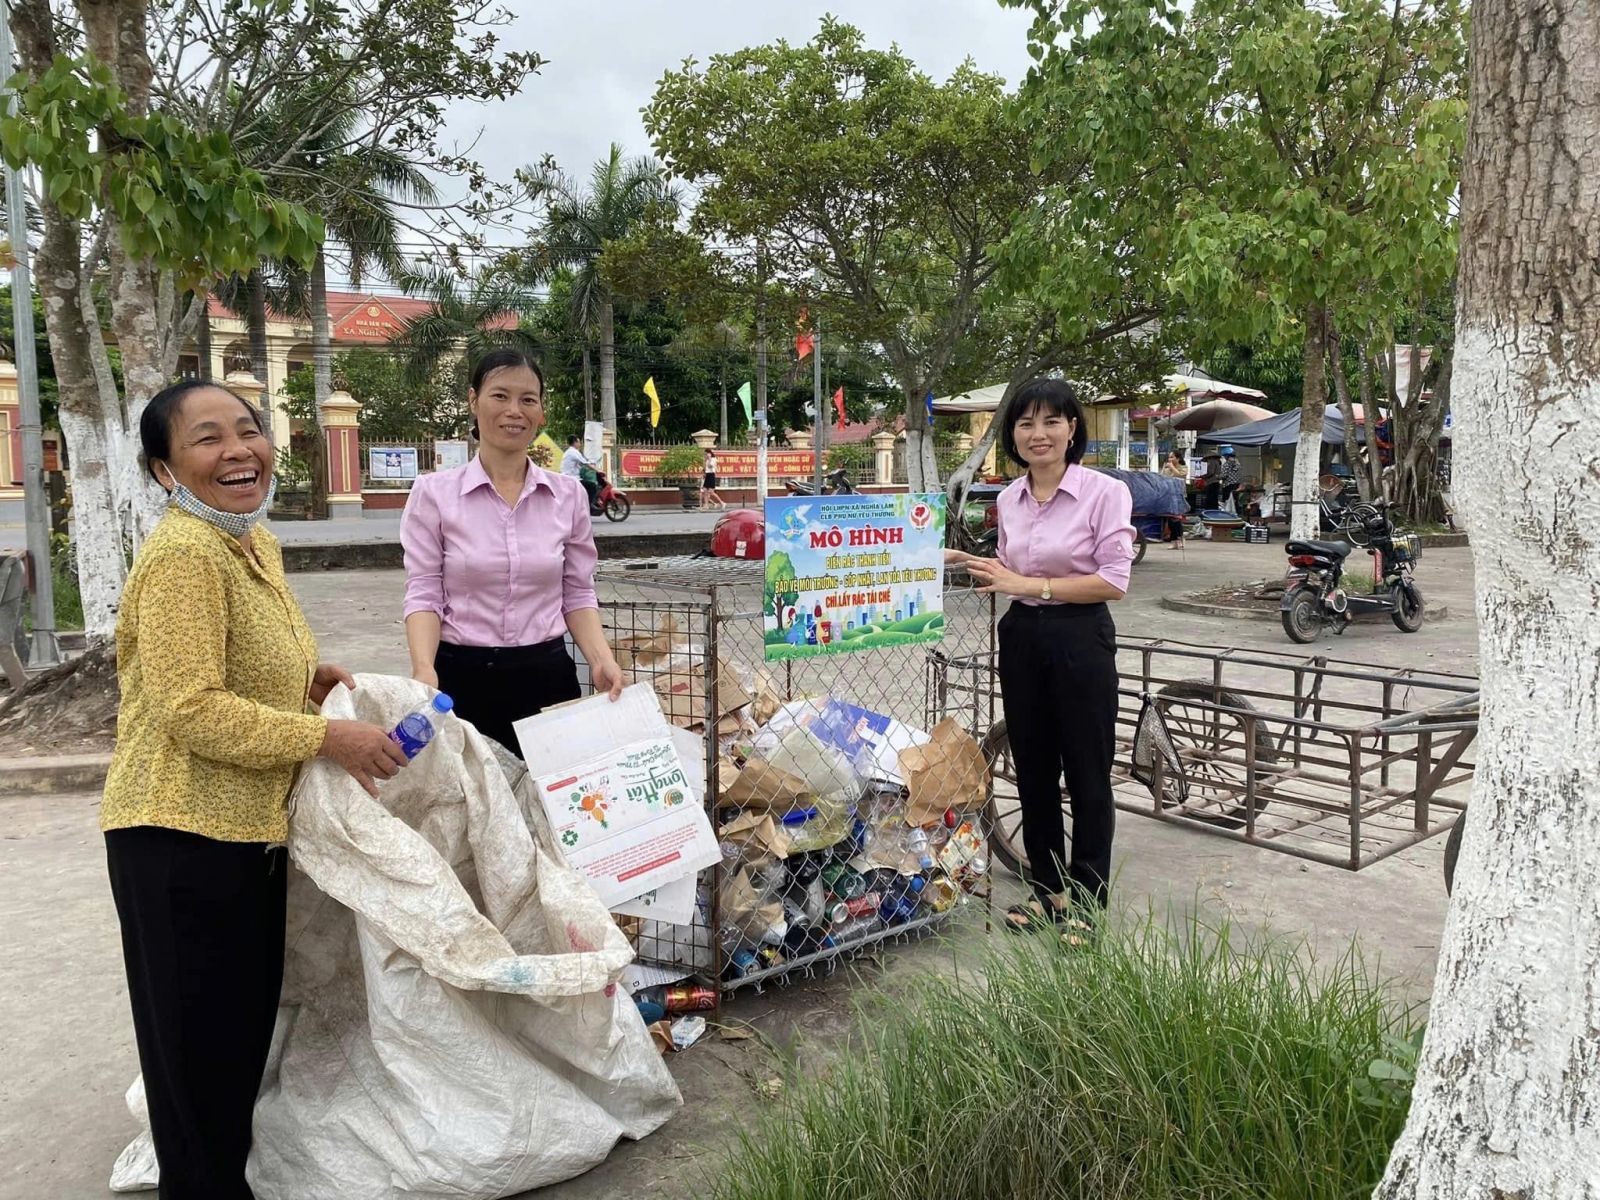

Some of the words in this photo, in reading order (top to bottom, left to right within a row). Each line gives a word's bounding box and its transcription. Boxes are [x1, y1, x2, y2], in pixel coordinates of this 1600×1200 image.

[809, 525, 843, 549] MÔ
[848, 524, 904, 547] HÌNH
[826, 551, 842, 570] BIẾN
[841, 552, 856, 569] RÁC
[856, 551, 877, 568] THÀNH
[774, 574, 788, 594] BẢO
[799, 574, 813, 592] MÔI
[813, 572, 839, 590] TRƯỜNG
[876, 571, 889, 586] LAN
[889, 566, 901, 584] TỎA
[901, 567, 913, 583] YÊU
[913, 566, 937, 582] THƯƠNG
[825, 591, 837, 608] CHỈ
[838, 590, 851, 607] LẤY
[852, 590, 866, 606] RÁC
[867, 589, 877, 605] TÁI
[878, 586, 892, 603] CHẾ
